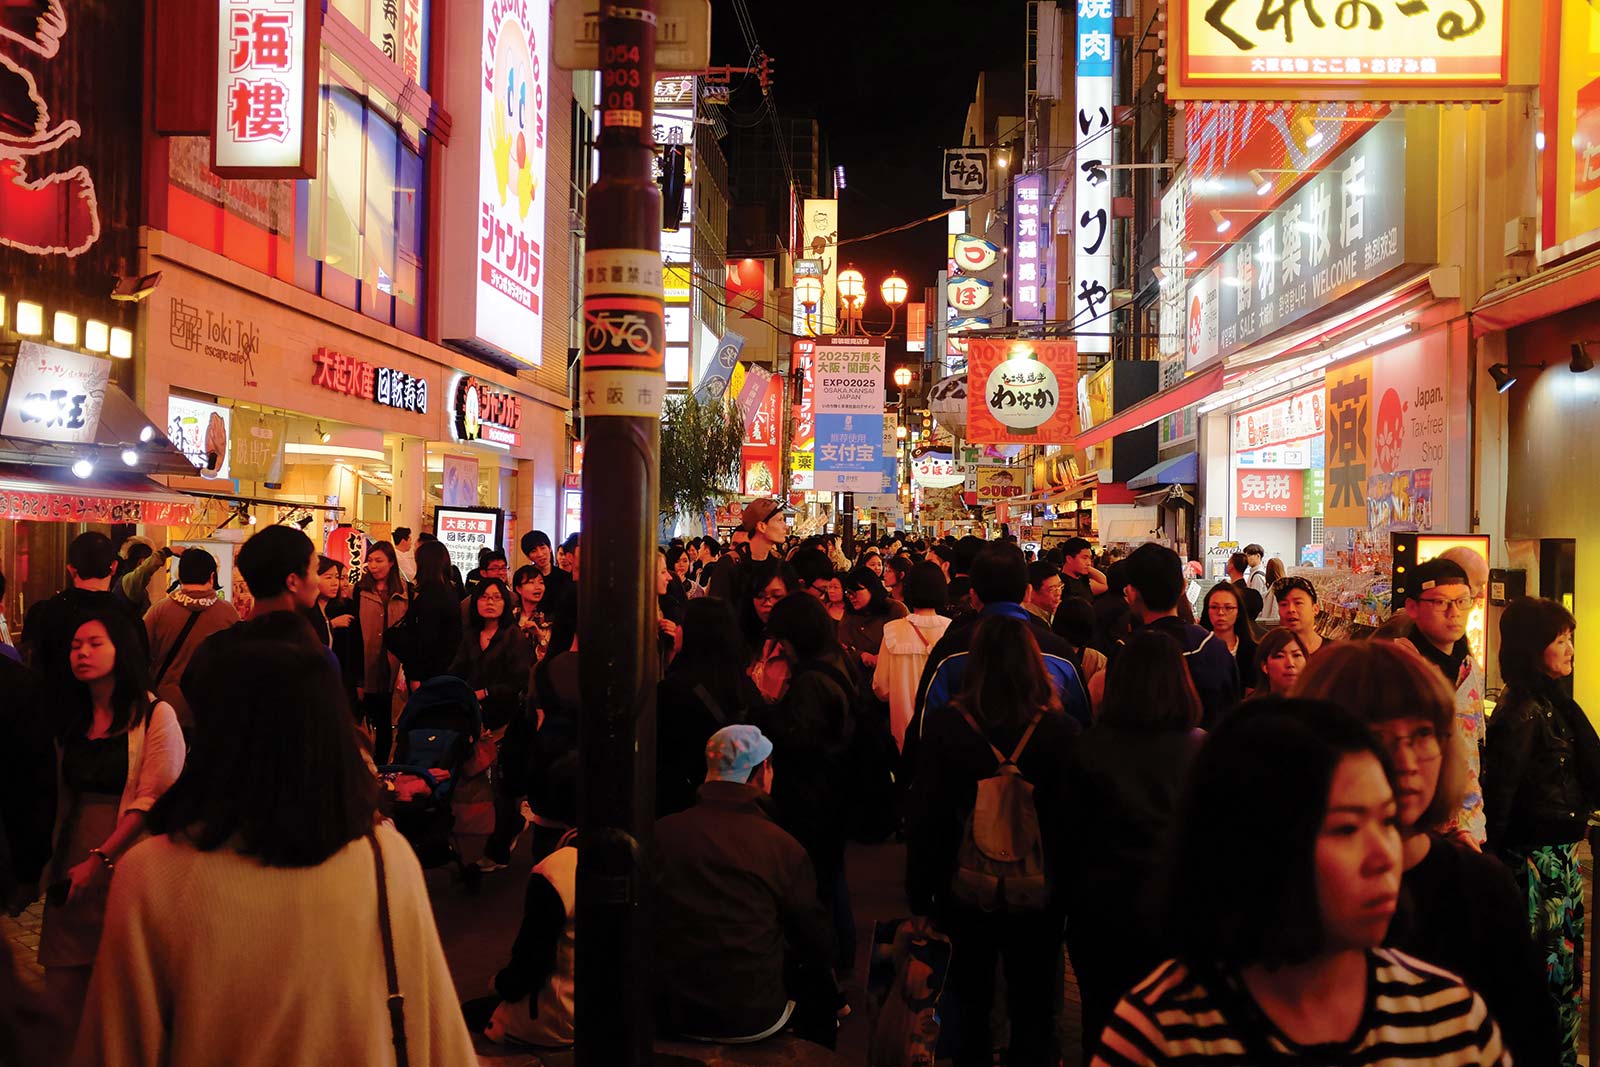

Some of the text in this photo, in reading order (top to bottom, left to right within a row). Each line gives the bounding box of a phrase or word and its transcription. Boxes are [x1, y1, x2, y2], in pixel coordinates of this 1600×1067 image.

[404, 0, 418, 82] 水産
[1079, 0, 1112, 61] 焼肉
[605, 45, 640, 63] 054
[1251, 58, 1437, 74] 大阪名物 たこ焼・お好み焼
[228, 0, 294, 143] 海樓
[606, 69, 640, 87] 903
[609, 91, 635, 109] 08
[950, 160, 983, 185] 牛角
[481, 202, 540, 288] ジャンカラ
[1311, 250, 1357, 299] WELCOME
[1278, 281, 1306, 317] 환영합니다
[205, 309, 232, 343] Toki
[236, 319, 260, 353] Toki
[1239, 311, 1255, 339] SALE
[204, 345, 245, 364] escape cafe
[818, 351, 882, 363] 2025万博を
[38, 359, 68, 378] ラーメン
[313, 347, 374, 400] 大起水産
[817, 362, 882, 375] 大阪・関西へ
[377, 368, 428, 415] 回転寿司
[584, 387, 652, 405] 大阪市
[823, 379, 877, 388] EXPO2025
[481, 385, 522, 429] ジャンカラ
[990, 385, 1055, 411] わなか
[1414, 386, 1444, 411] Japan.
[1411, 411, 1444, 439] Tax-free
[236, 438, 278, 466] 脱出ゲー
[820, 444, 876, 463] 支付宝
[1329, 374, 1368, 509] 薬
[1421, 441, 1444, 466] Shop
[1241, 473, 1291, 500] 免税
[76, 500, 109, 518] ラーメン
[1242, 502, 1288, 512] Tax-Free
[446, 518, 487, 531] 大起水産
[446, 531, 486, 544] 回転寿司
[347, 533, 362, 584] たこ焼
[1207, 546, 1244, 556] Kaneb
[170, 590, 218, 607] Suprem
